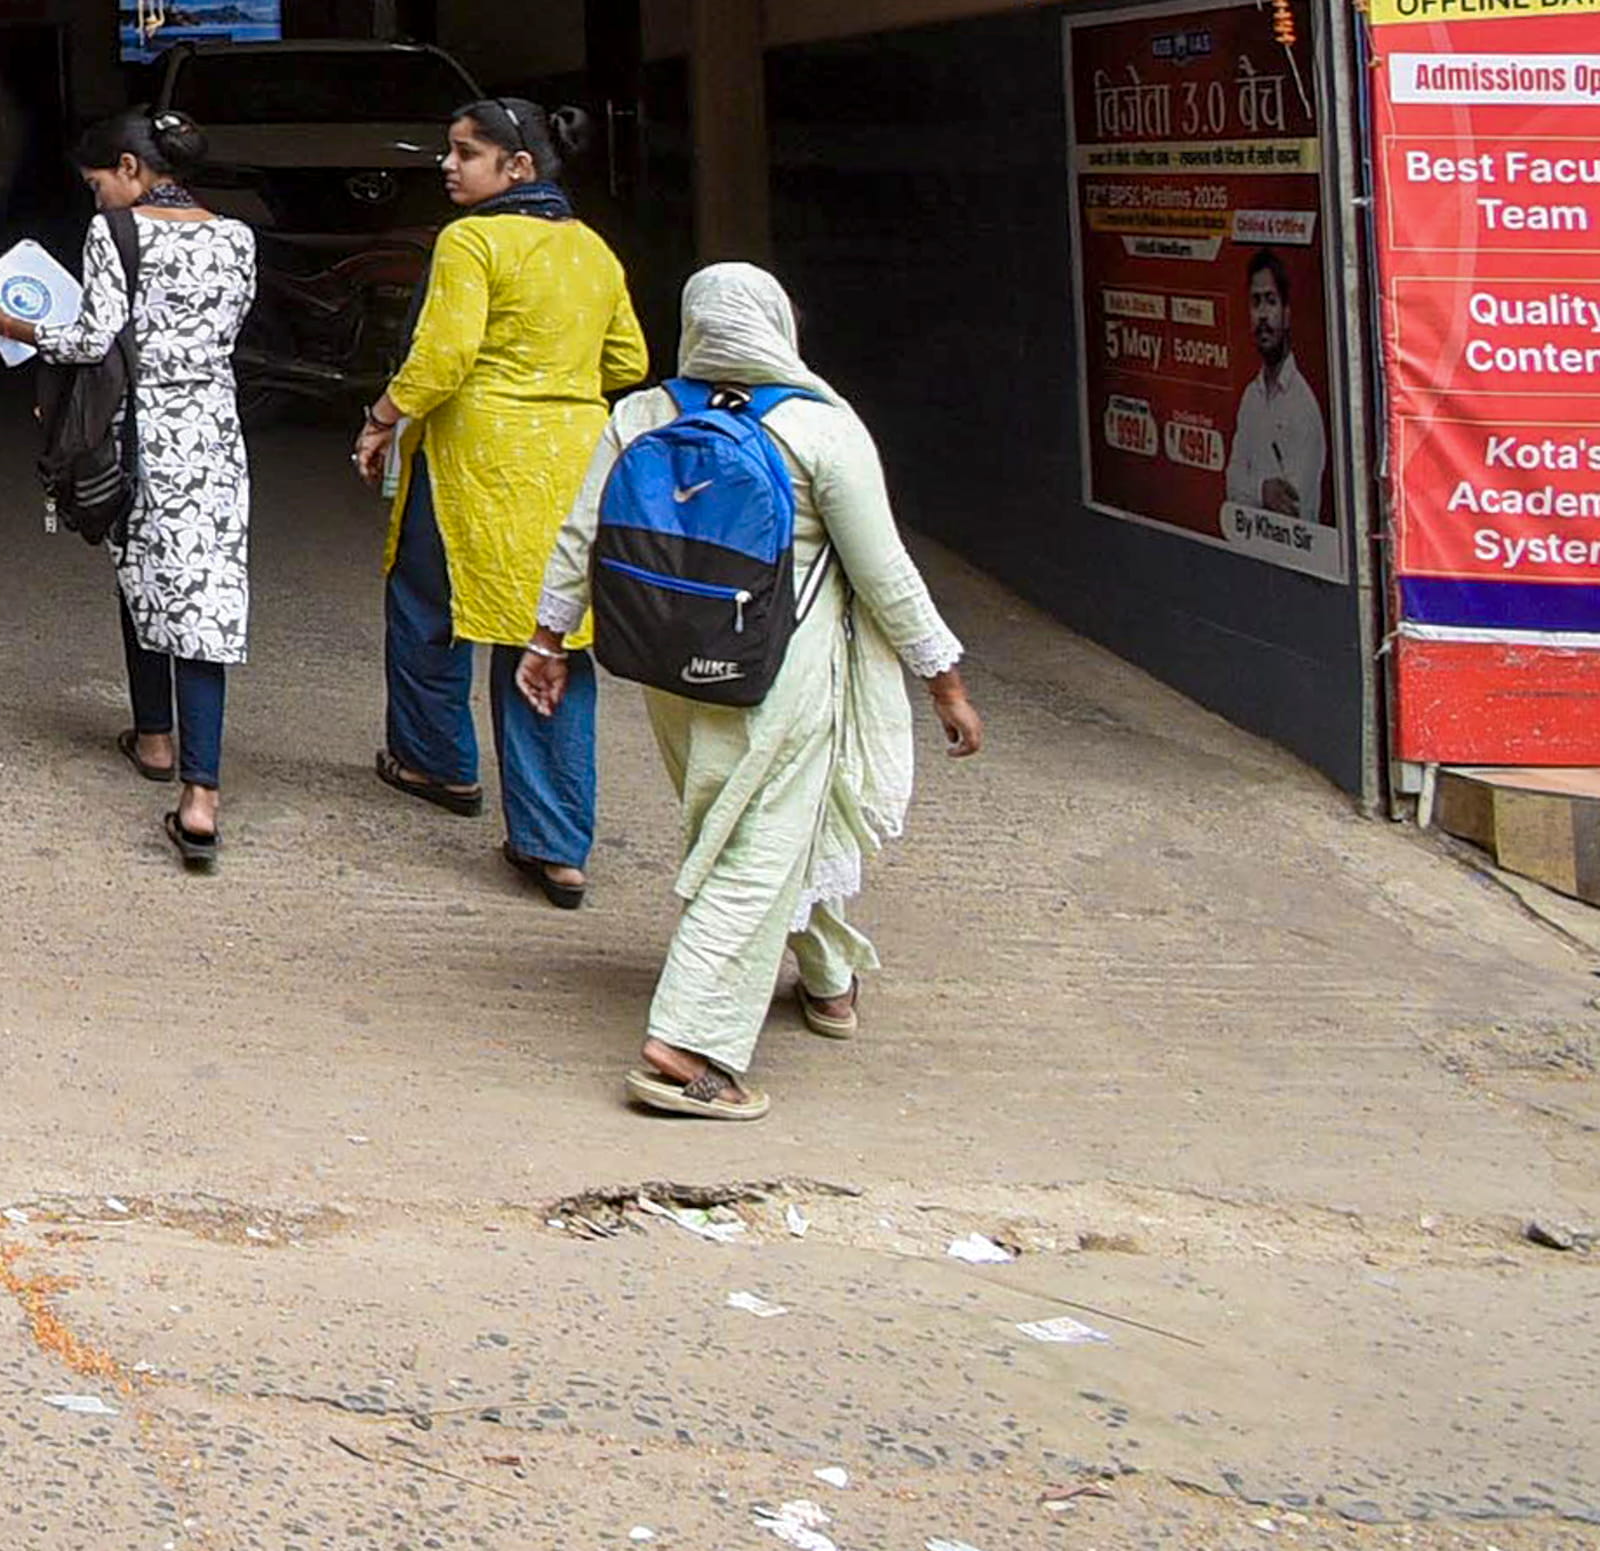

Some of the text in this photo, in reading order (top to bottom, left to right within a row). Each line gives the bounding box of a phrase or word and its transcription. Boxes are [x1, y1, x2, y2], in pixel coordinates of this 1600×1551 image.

[1415, 62, 1567, 92] Admissions
[1406, 150, 1600, 184] Best Facu
[1476, 198, 1588, 231] Team
[1121, 326, 1163, 371] May
[1234, 509, 1312, 553] By Khan Sir
[690, 657, 740, 676] NIKE
